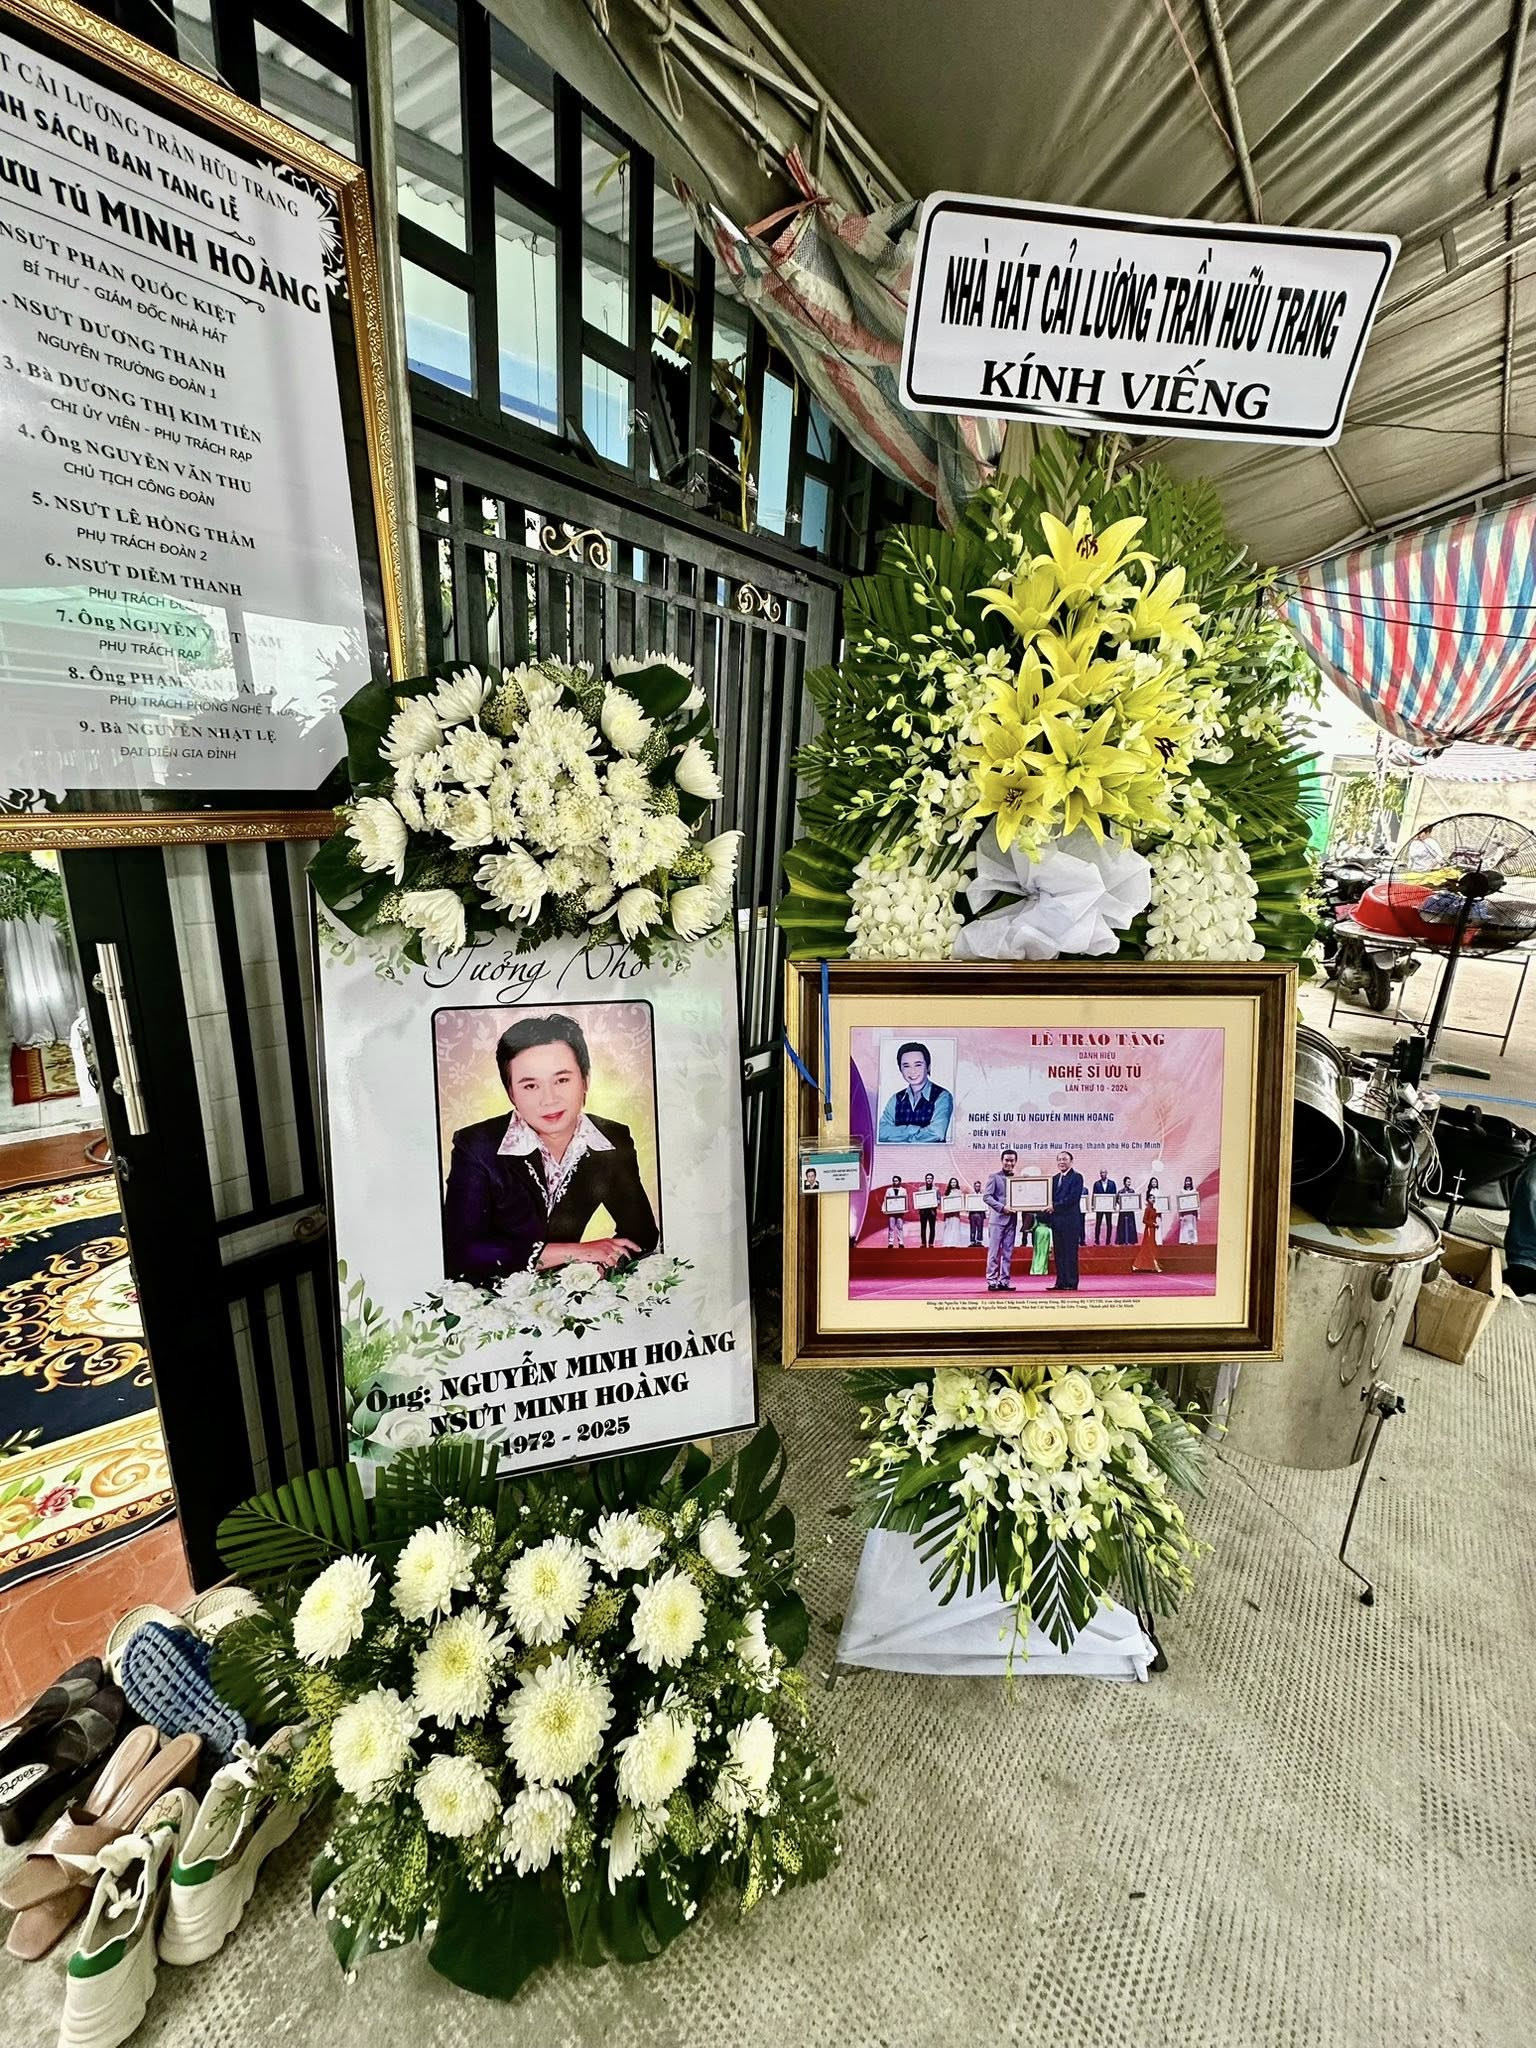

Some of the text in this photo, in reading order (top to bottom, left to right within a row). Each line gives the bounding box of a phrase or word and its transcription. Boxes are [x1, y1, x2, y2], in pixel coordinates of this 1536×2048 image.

[34, 108, 99, 156] SÁCH
[105, 142, 153, 181] BAN
[157, 167, 214, 210] TANG
[219, 195, 240, 222] LỄ
[63, 84, 139, 137] LƯƠNG
[242, 175, 299, 217] TRANG
[49, 176, 91, 217] TÚ
[96, 190, 198, 264] MINH
[206, 239, 321, 314] HOÀNG
[23, 259, 40, 277] BÍ
[45, 266, 80, 289] THƯ
[94, 286, 132, 310] GIÁM
[171, 314, 199, 335] NHÀ
[202, 327, 228, 345] HÁT
[66, 246, 125, 283] PHAN
[193, 297, 236, 325] KIỆT
[941, 238, 1347, 359] NHÀ HÁT CẢI LƯƠNG TRẦN HỮU TRANG
[12, 292, 226, 379] NSƯT DƯƠNG THANH
[38, 331, 99, 361] NGUYÊN
[169, 374, 205, 396] ĐOÀN
[210, 388, 217, 400] 1
[980, 352, 1271, 420] KÍNH VIẾNG
[3, 355, 22, 374] 3.
[27, 361, 53, 382] Bà
[58, 371, 136, 407] DƯƠNG
[140, 396, 176, 422] THỊ
[180, 408, 218, 431] KIM
[50, 398, 78, 415] CHI
[83, 404, 102, 421] ỦY
[107, 413, 140, 433] VIÊN
[154, 427, 181, 445] PHỤ
[185, 435, 226, 456] TRÁCH
[230, 448, 253, 463] RẠP
[18, 423, 35, 439] 4.
[41, 425, 82, 454] Ông
[174, 463, 212, 484] VĂN
[216, 473, 251, 493] THU
[64, 462, 215, 507] CHỦ TỊCH CÔNG ĐOÀN
[32, 491, 49, 507] 5.
[54, 495, 110, 519] NSƯT
[116, 508, 141, 526] LÊ
[77, 527, 207, 561] PHỤ TRÁCH ĐOÀN 2
[45, 553, 61, 567] 6.
[66, 555, 121, 577] NSƯT
[180, 575, 242, 596] THANH
[89, 586, 117, 602] PHỤ
[121, 591, 165, 607] TRÁCH
[56, 609, 73, 623] 7.
[78, 608, 115, 631] Ông
[99, 640, 202, 662] PHỤ TRÁCH RẠP
[68, 666, 85, 680] 8.
[90, 665, 126, 686] Ông
[130, 672, 183, 689] PHẠM
[110, 695, 137, 708] PHỤ
[142, 696, 182, 709] TRÁCH
[79, 721, 95, 733] 9.
[101, 721, 122, 734] Bà
[257, 729, 277, 744] LỆ
[120, 747, 143, 758] ĐẠI
[182, 748, 203, 758] GIA
[207, 747, 236, 759] ĐÌNH
[1059, 1033, 1110, 1046] TRAO
[1116, 1031, 1165, 1048] TẶNG
[1079, 1052, 1098, 1060] DANH
[1048, 1063, 1141, 1080] NGHỆ SĨ ƯU TÚ
[1097, 1084, 1105, 1092] 10
[1111, 1084, 1128, 1092] 2024
[1063, 1113, 1085, 1122] MINH
[366, 1330, 736, 1414] Ông: NGUYỄN MINH HOÀNG
[429, 1372, 689, 1438] NSƯT MINH HOÀNG
[499, 1429, 556, 1458] 1972
[577, 1415, 631, 1443] 2025
